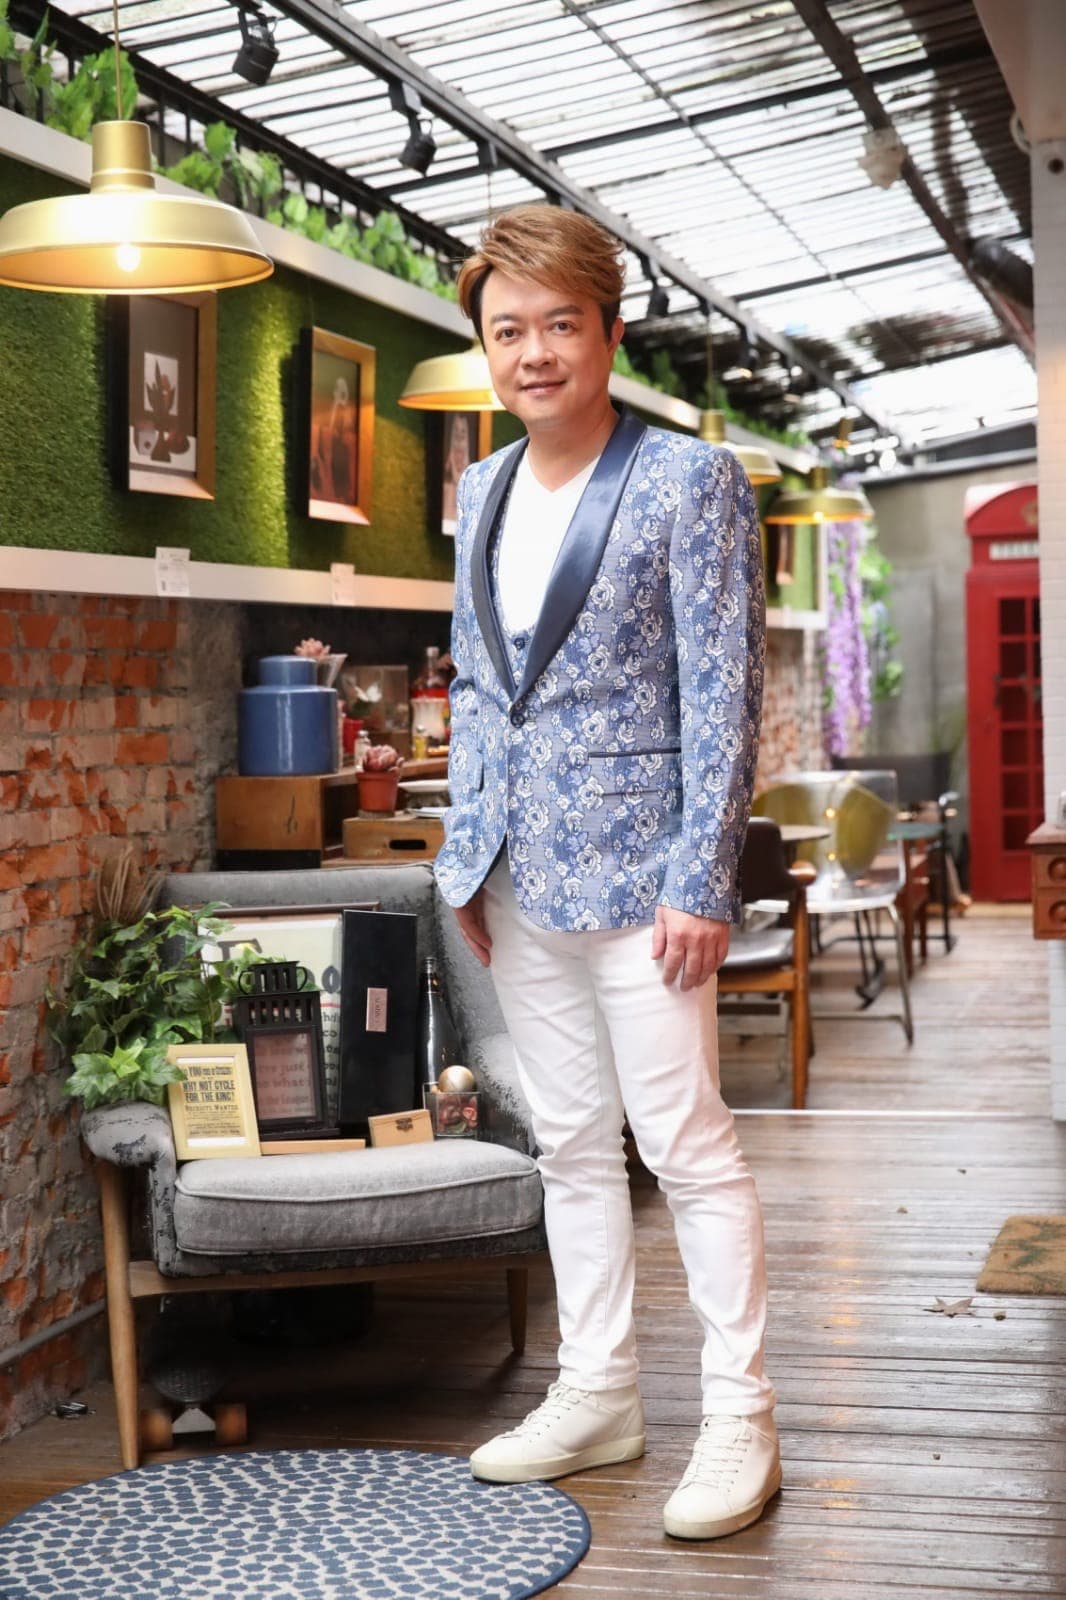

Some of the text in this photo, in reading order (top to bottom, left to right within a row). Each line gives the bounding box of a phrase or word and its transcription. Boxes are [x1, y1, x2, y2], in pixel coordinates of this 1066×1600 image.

[183, 1080, 236, 1092] WHY NOT CYCLE
[185, 1093, 199, 1103] FOR
[202, 1092, 214, 1102] THE
